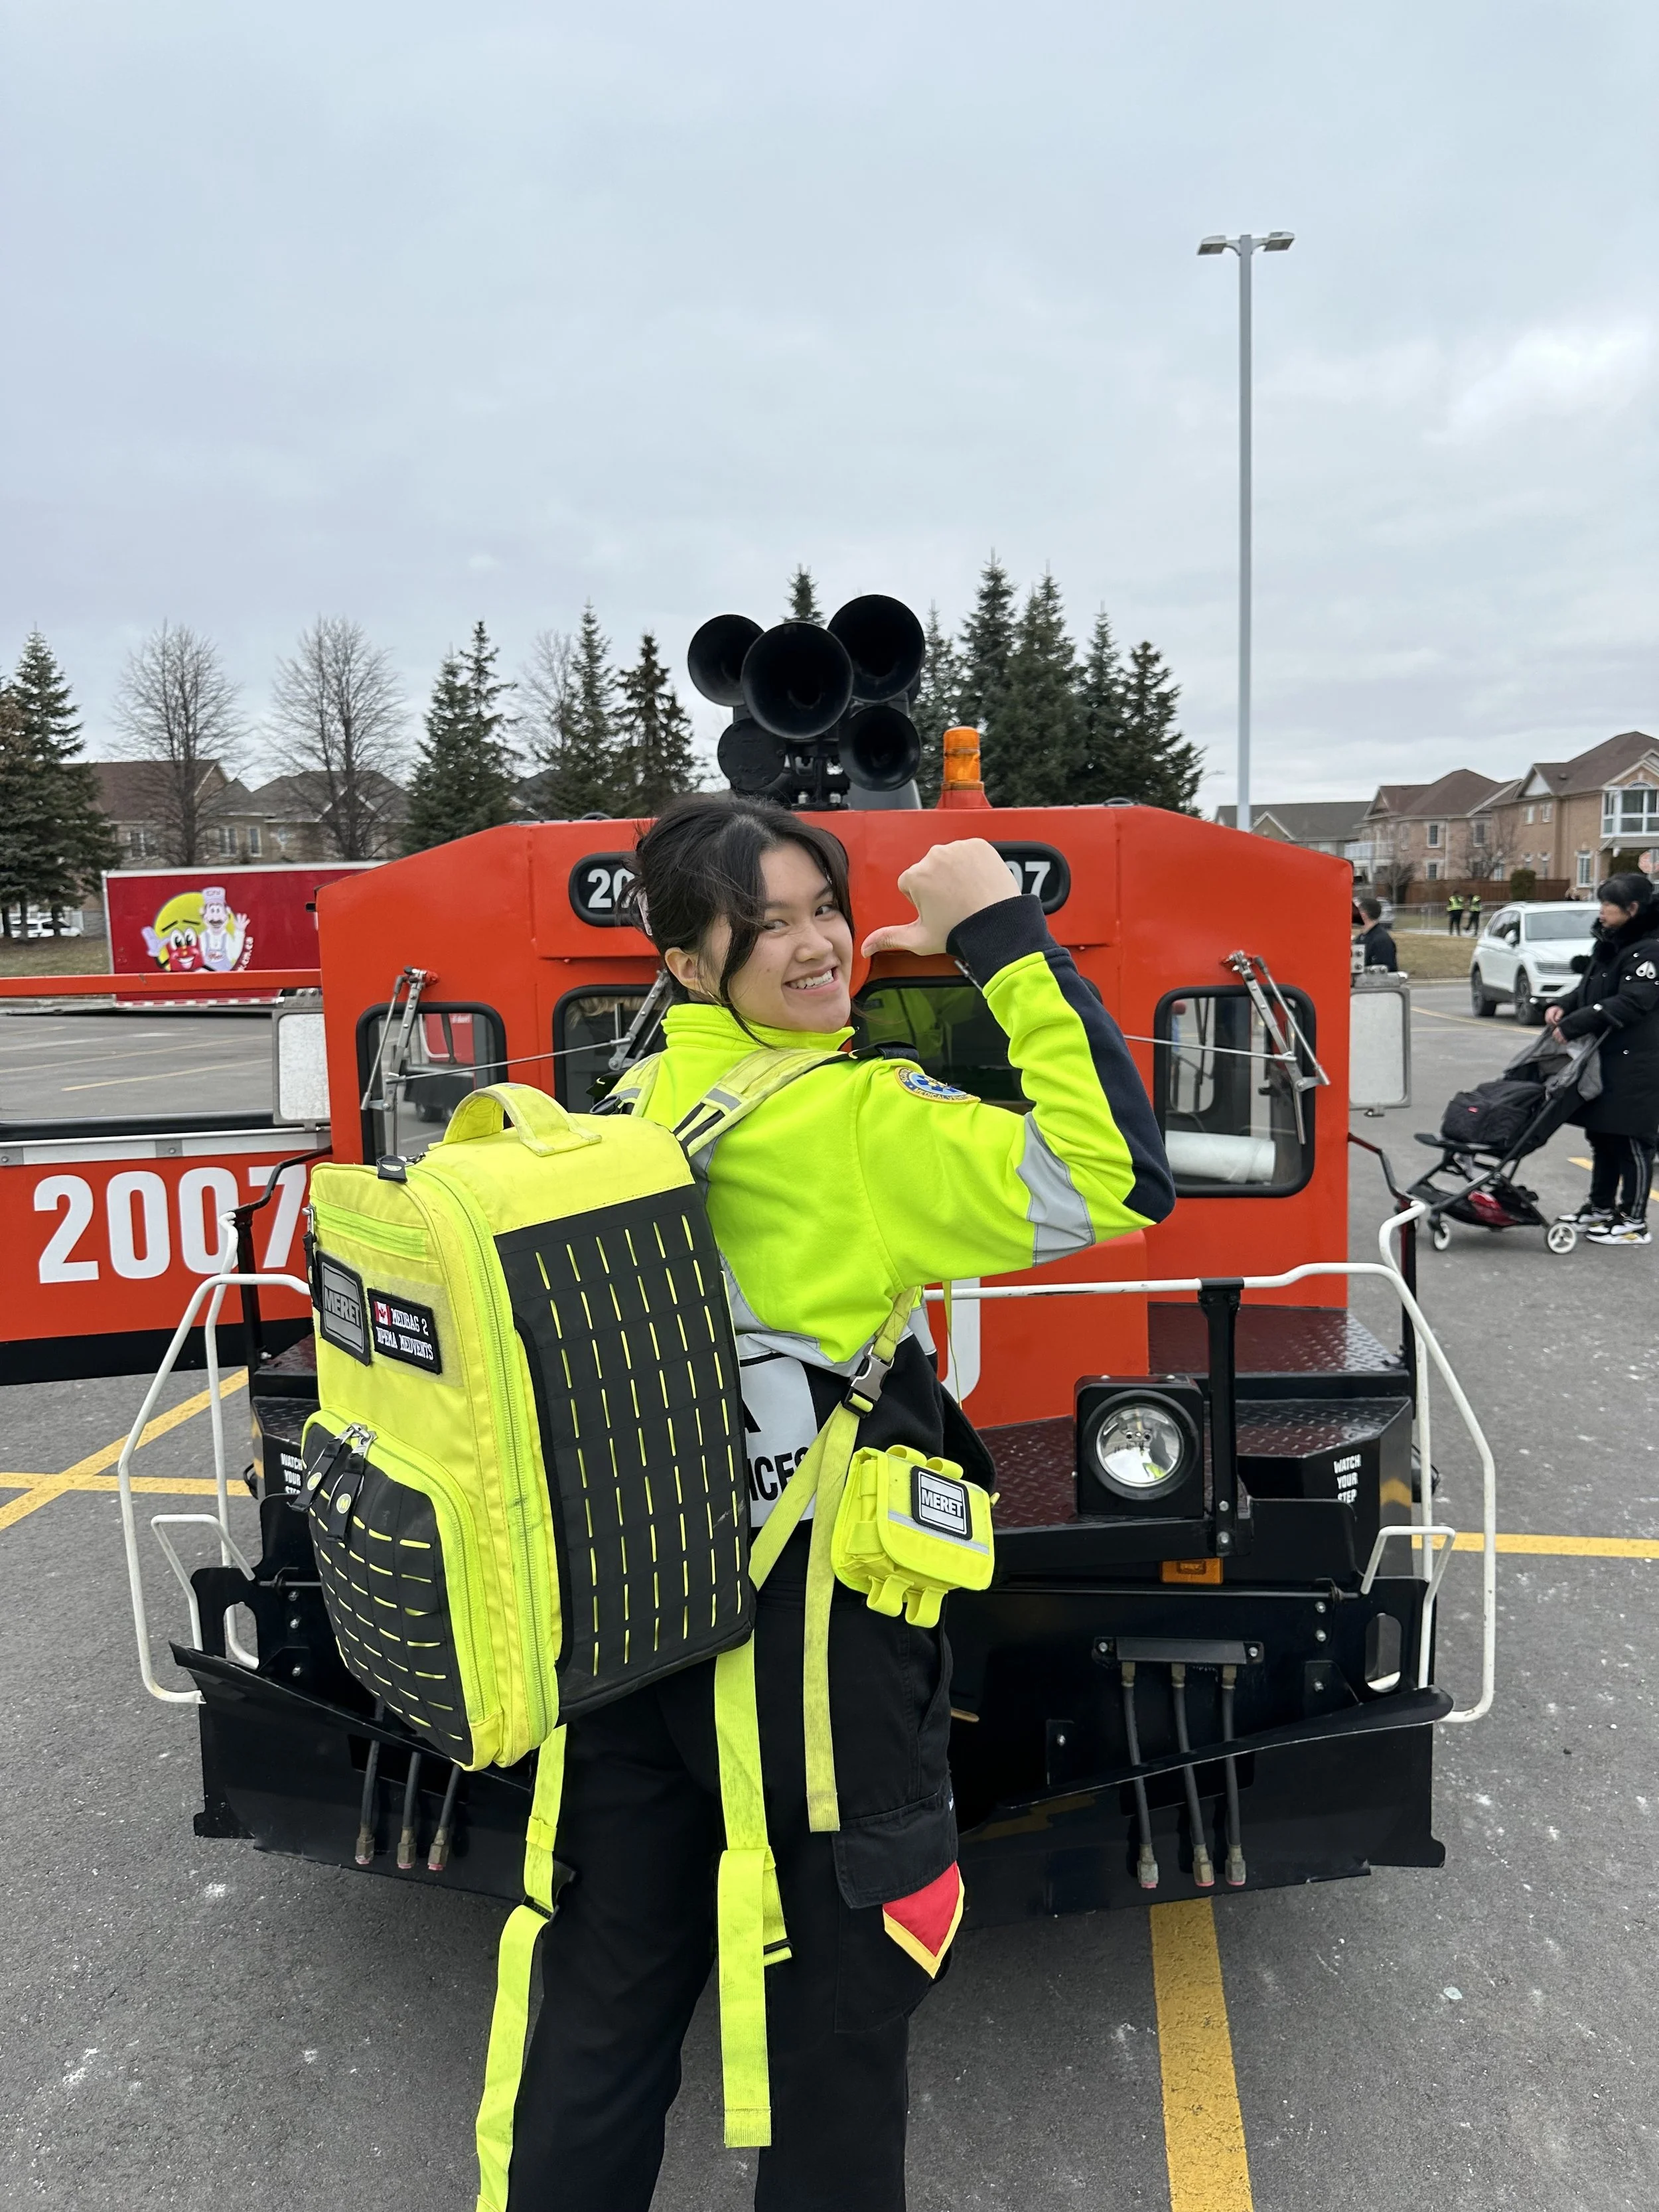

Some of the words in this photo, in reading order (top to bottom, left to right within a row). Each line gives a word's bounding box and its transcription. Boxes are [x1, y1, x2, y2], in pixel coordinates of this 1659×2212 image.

[587, 868, 635, 909] 20
[34, 1163, 307, 1284] 2007
[325, 1288, 360, 1327] MERET
[391, 1307, 420, 1333] MEDBAG
[421, 1318, 429, 1336] 2
[280, 1453, 303, 1471] WATCH
[1334, 1453, 1362, 1473] WATCH
[283, 1469, 301, 1487] YOUR
[1336, 1472, 1358, 1490] YOUR
[921, 1488, 963, 1517] MERET
[1337, 1489, 1358, 1504] STEP
